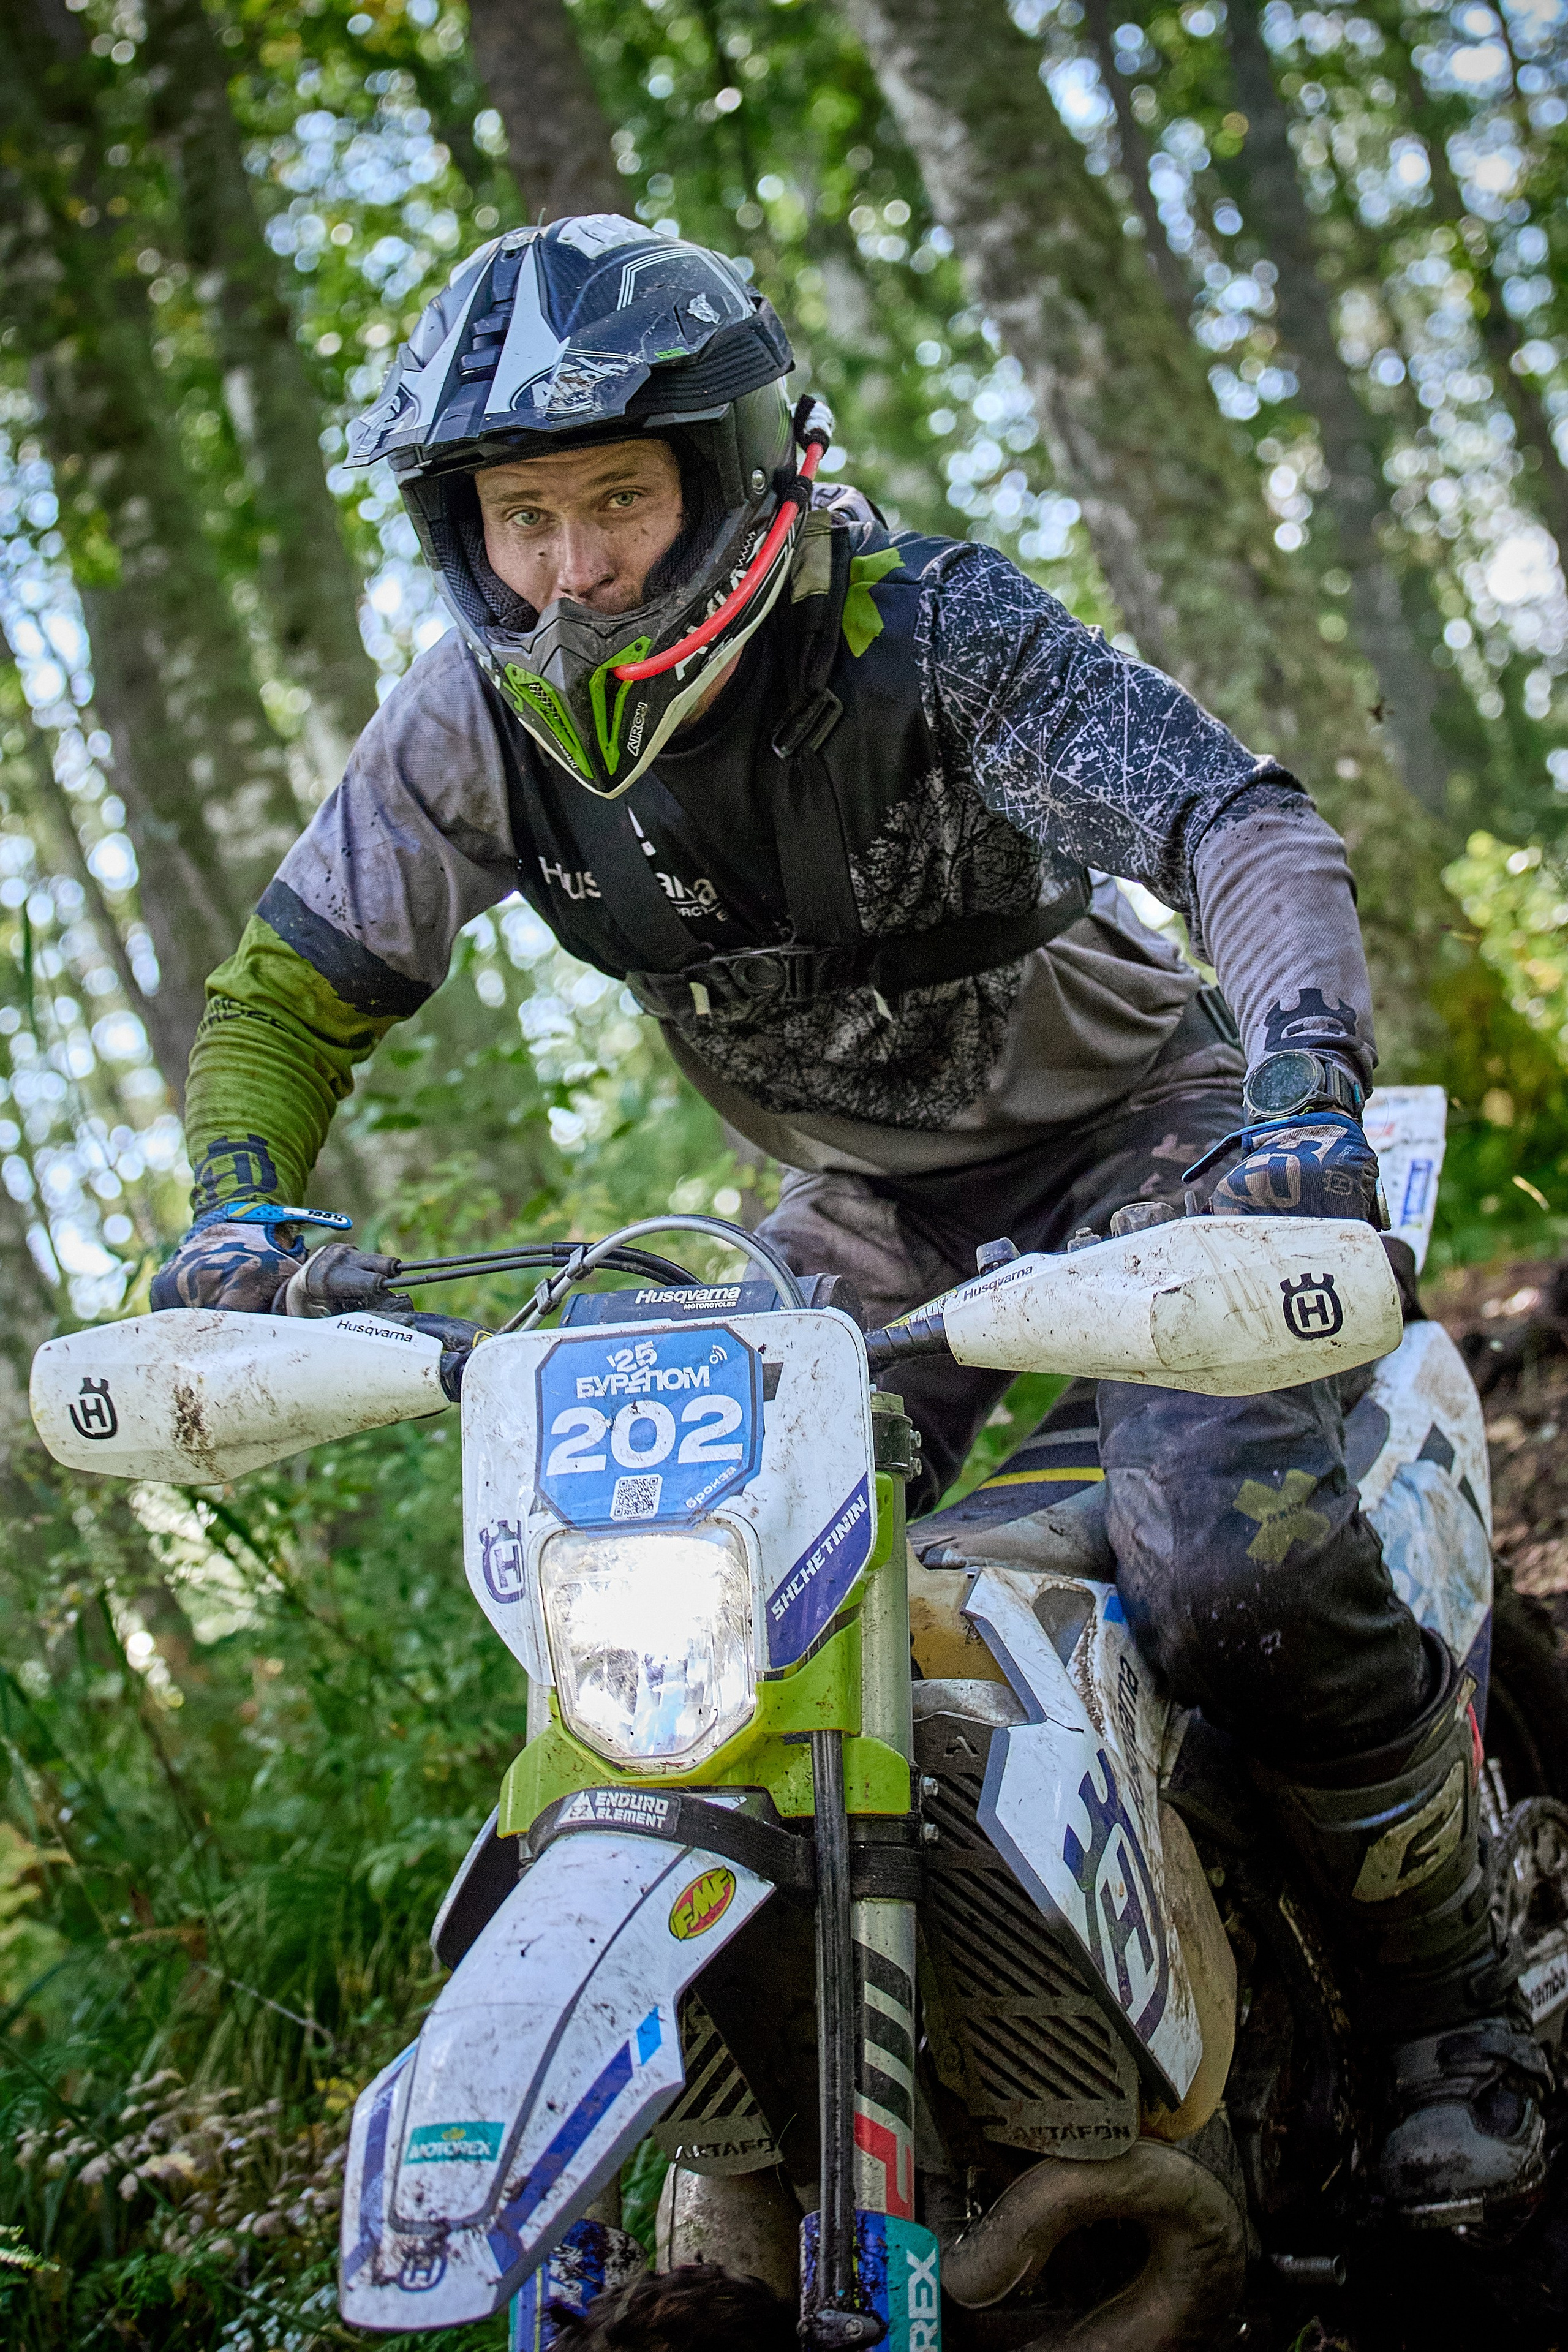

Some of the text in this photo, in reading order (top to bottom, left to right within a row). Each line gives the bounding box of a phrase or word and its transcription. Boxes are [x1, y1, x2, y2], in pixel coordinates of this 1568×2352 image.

[308, 1210, 343, 1222] 100%
[963, 1265, 1033, 1302] Husqvarna
[635, 1287, 741, 1305] Husqvarna
[683, 1300, 737, 1311] MOTORCYCLES
[336, 1319, 413, 1343] Husqvarna
[546, 1394, 743, 1476] 202
[771, 1494, 867, 1622] SHCHETININ
[594, 1791, 669, 1815] ENDURO
[595, 1807, 665, 1829] ELEMENT
[673, 1866, 730, 1940] FMF
